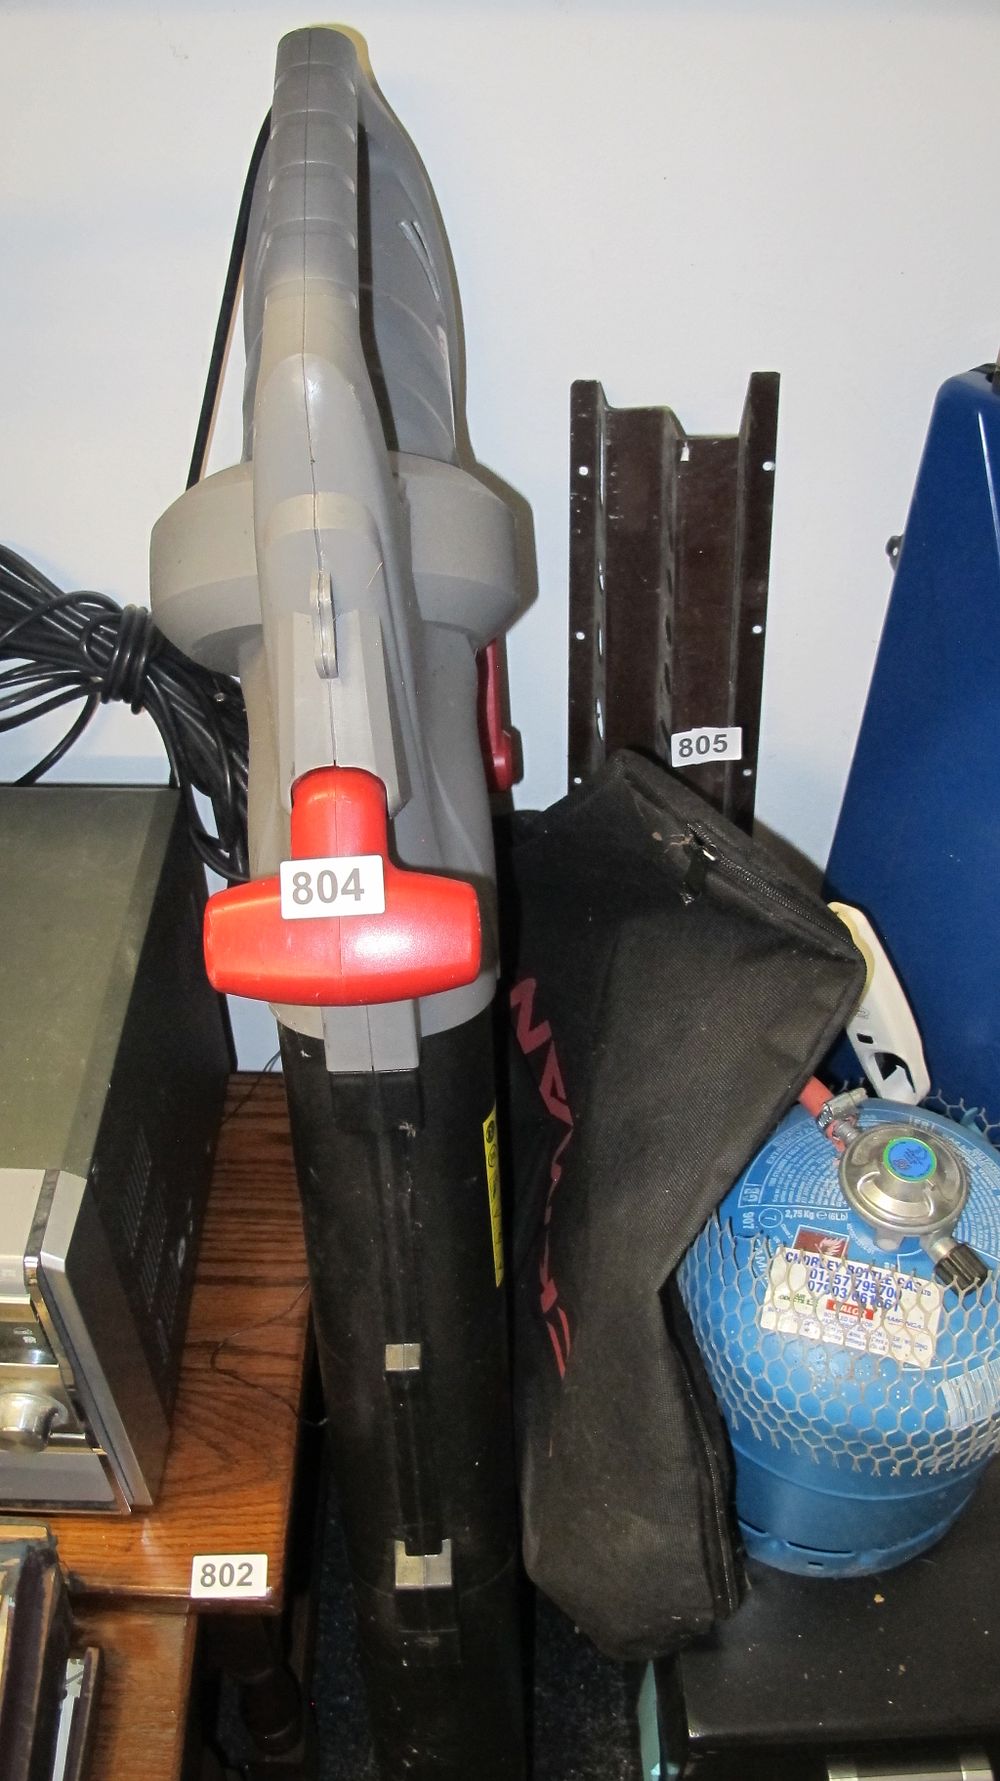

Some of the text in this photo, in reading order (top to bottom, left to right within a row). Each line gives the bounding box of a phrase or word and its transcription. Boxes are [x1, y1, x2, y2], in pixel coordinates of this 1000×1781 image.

[679, 734, 728, 757] 805
[292, 868, 365, 905] 804
[201, 1563, 253, 1587] 802
